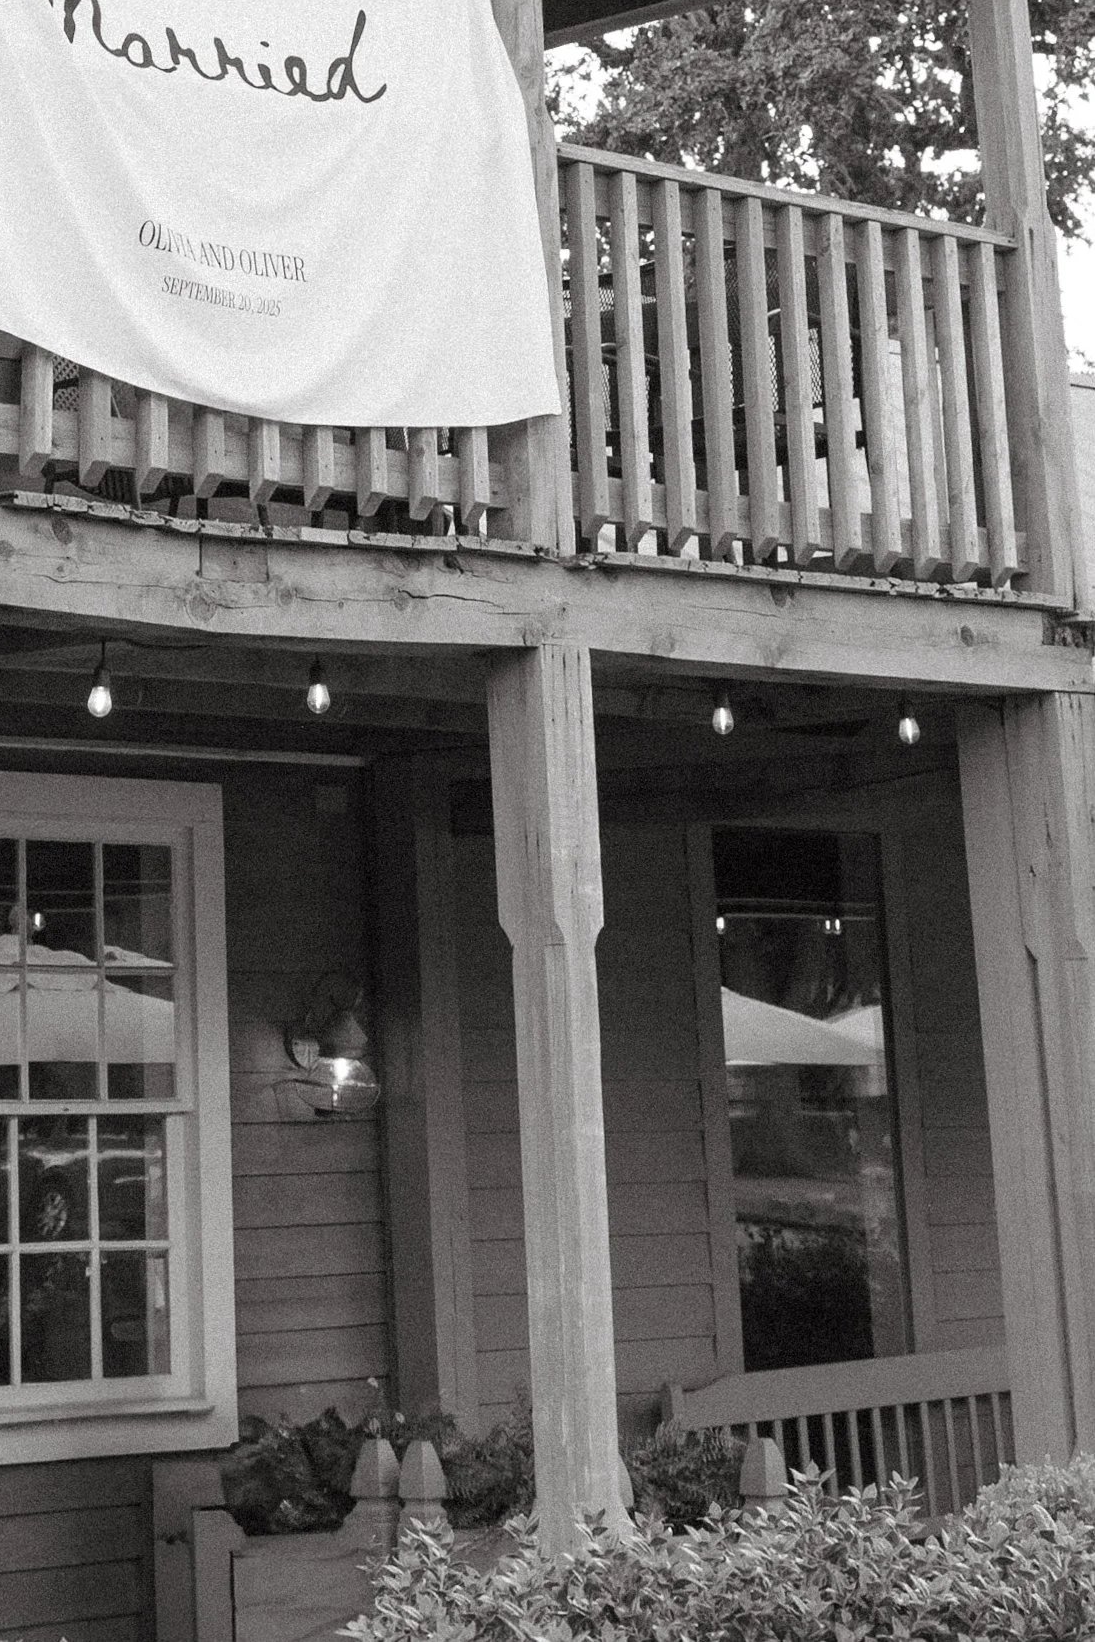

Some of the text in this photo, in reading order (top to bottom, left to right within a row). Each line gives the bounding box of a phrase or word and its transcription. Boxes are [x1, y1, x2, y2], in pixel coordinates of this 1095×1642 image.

[199, 240, 236, 272] AND
[238, 248, 308, 283] OLIVER
[161, 275, 236, 309] SEPTEMBER
